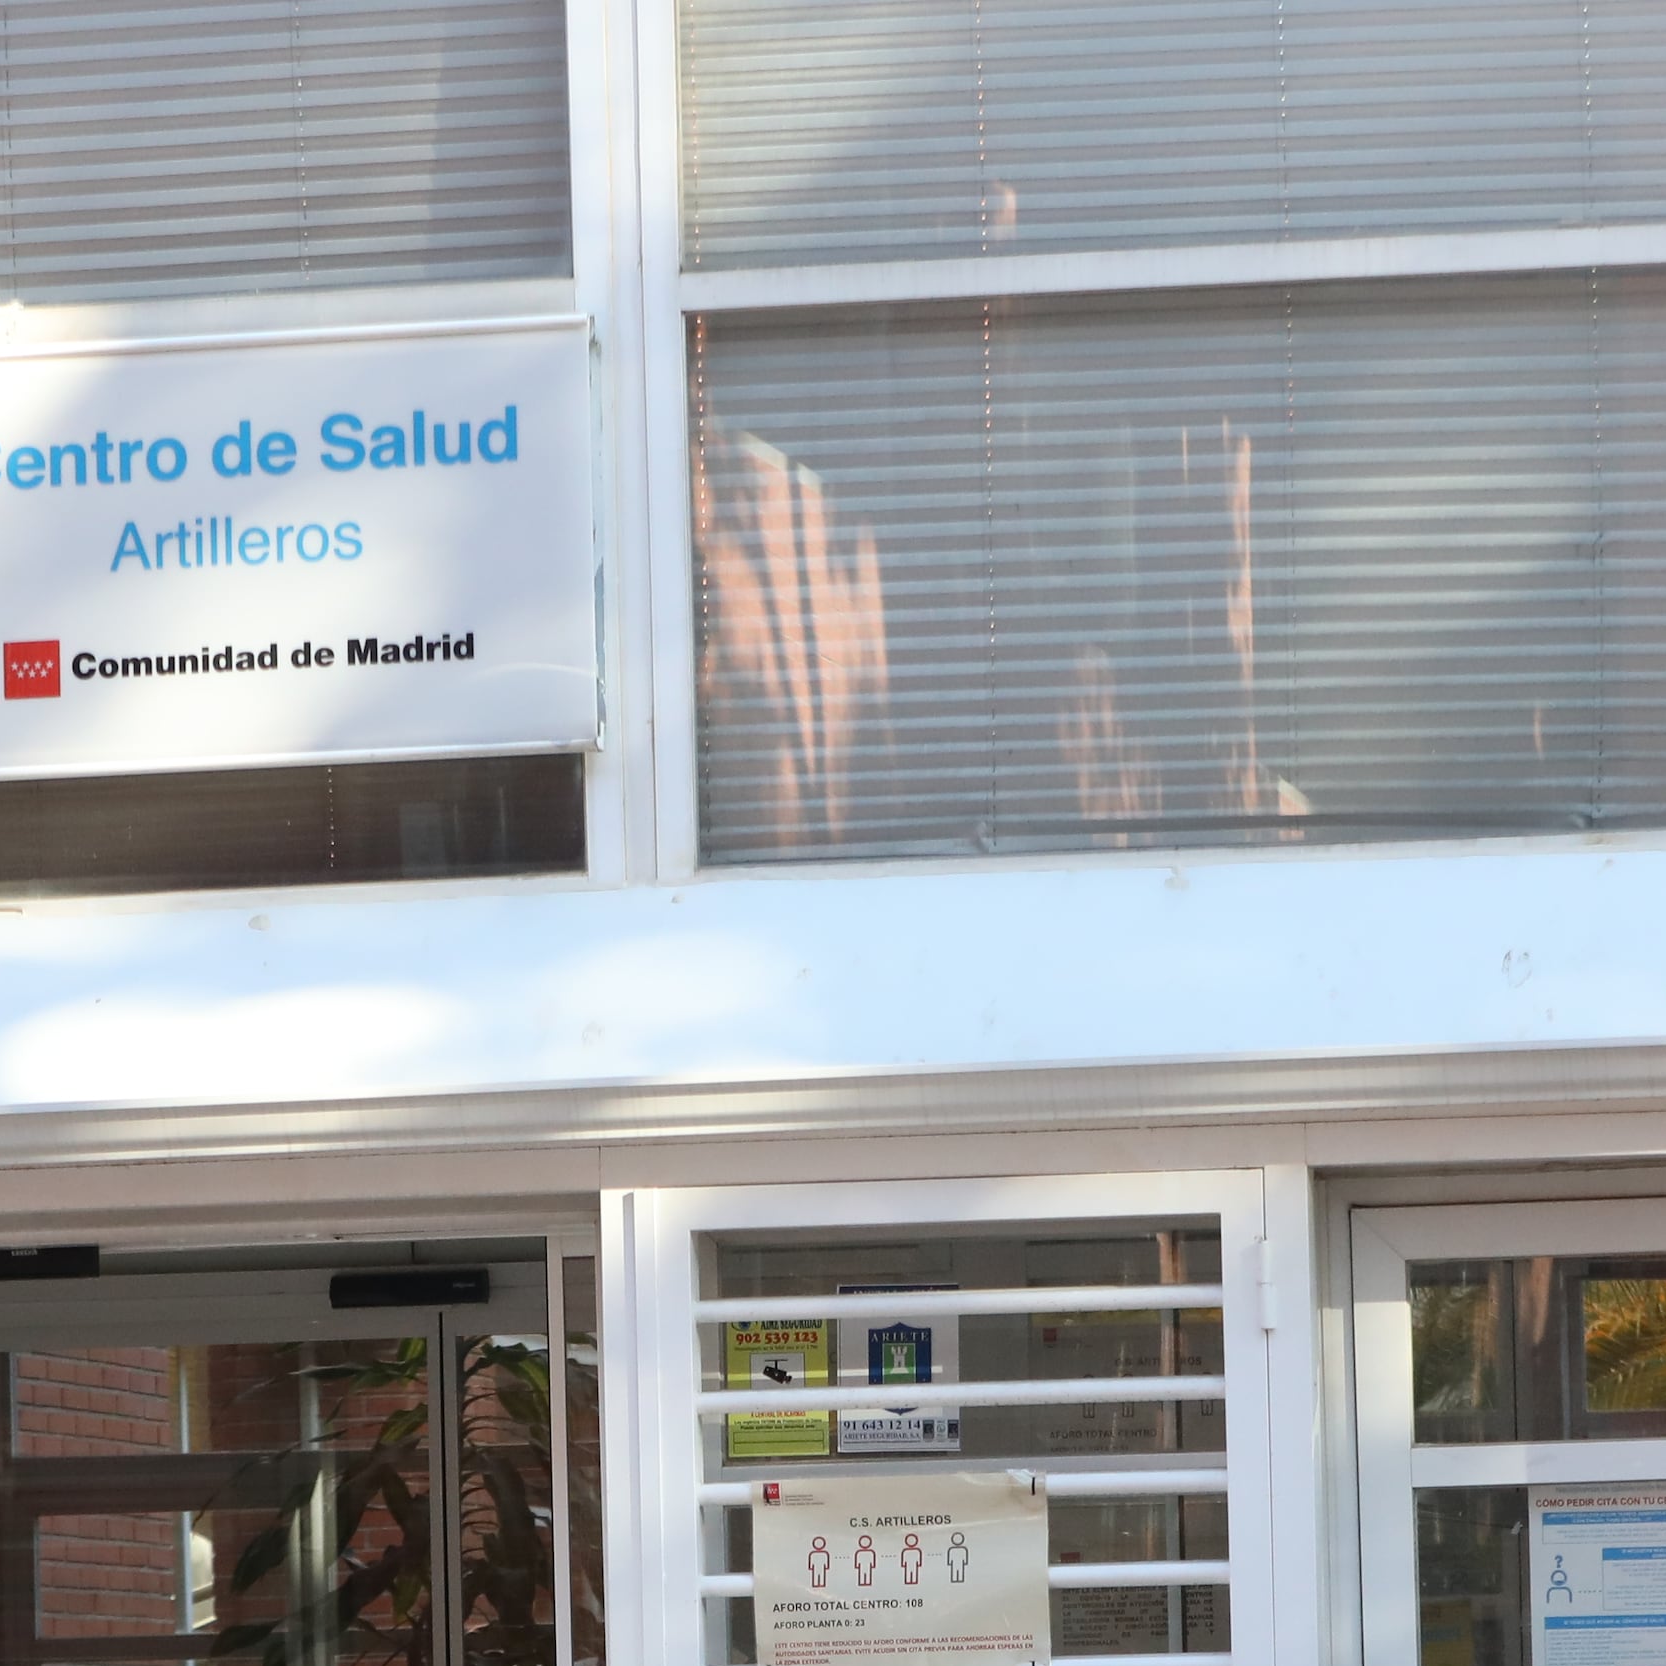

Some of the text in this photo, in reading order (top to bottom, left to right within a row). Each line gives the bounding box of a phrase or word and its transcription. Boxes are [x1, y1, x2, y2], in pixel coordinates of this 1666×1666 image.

[211, 420, 297, 477] de
[320, 405, 518, 472] Salud
[109, 515, 364, 573] Artilleros
[71, 632, 475, 680] Comunidad de Madrid
[736, 1332, 818, 1345] 902 539 123
[871, 1331, 929, 1343] ARIETE
[843, 1420, 921, 1431] 91 643 12 14
[1536, 1497, 1564, 1508] CÓMO
[1566, 1498, 1595, 1507] PEDIR
[1597, 1497, 1617, 1506] CITA
[1620, 1497, 1641, 1506] CON
[1643, 1496, 1655, 1505] TU
[849, 1515, 952, 1528] C.S. ARTILLEROS
[772, 1598, 924, 1612] AFORO TOTAL CENTRO: 108
[773, 1619, 865, 1630] AFORO PLANTA 0: 23
